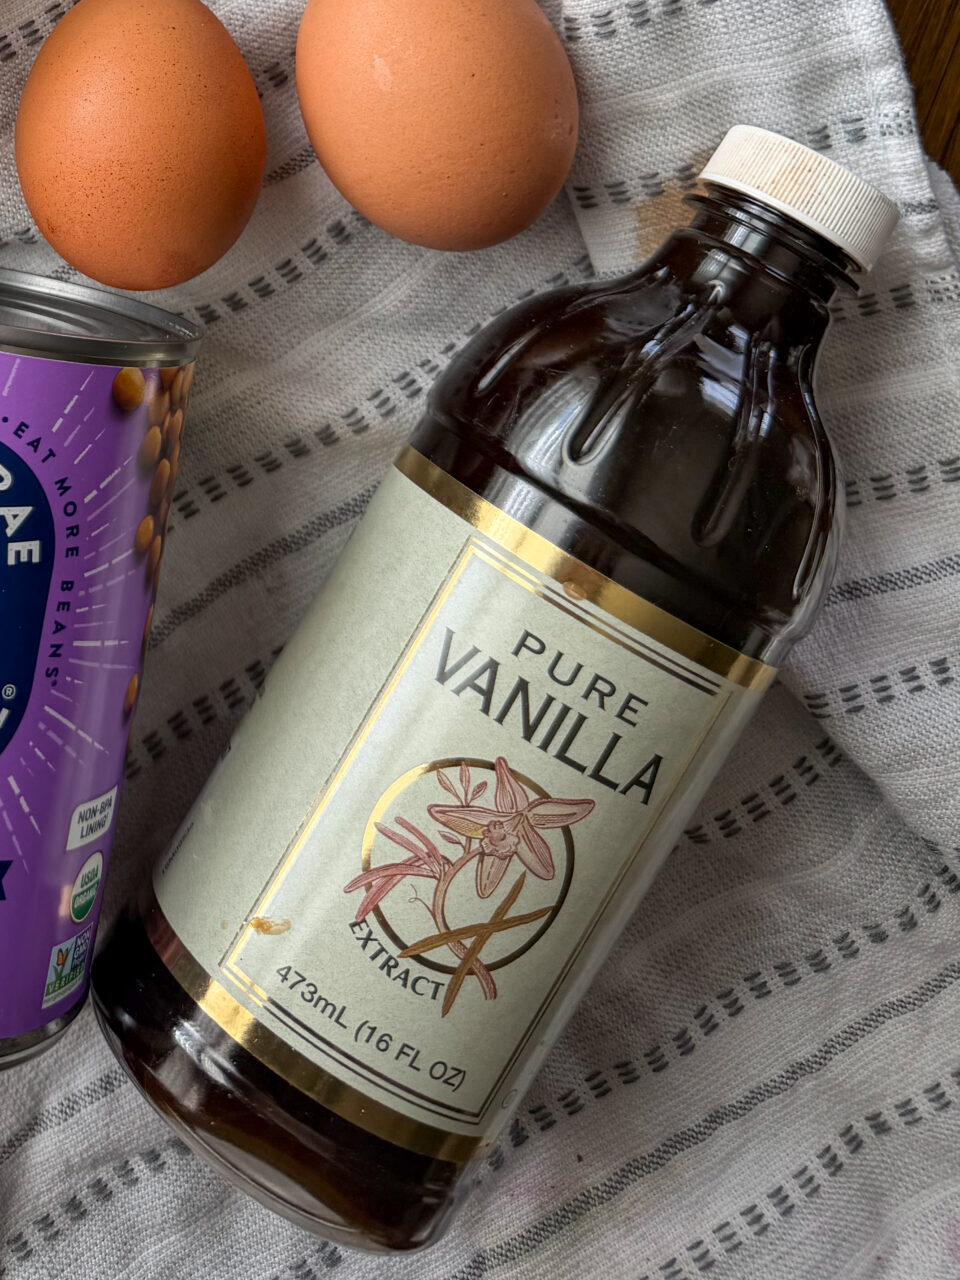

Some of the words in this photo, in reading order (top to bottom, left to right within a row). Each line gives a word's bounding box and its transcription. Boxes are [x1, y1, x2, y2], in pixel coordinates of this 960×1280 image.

[13, 420, 57, 464] EAT
[54, 476, 80, 559] MORE
[433, 626, 665, 806] VANILLA
[510, 628, 650, 728] PURE
[77, 795, 113, 825] NON-BPA
[349, 919, 446, 1001] EXTRACT
[276, 964, 349, 1030] 473mL
[354, 1019, 394, 1053] (16
[394, 1042, 422, 1072] FL
[428, 1060, 467, 1093] OZ)
